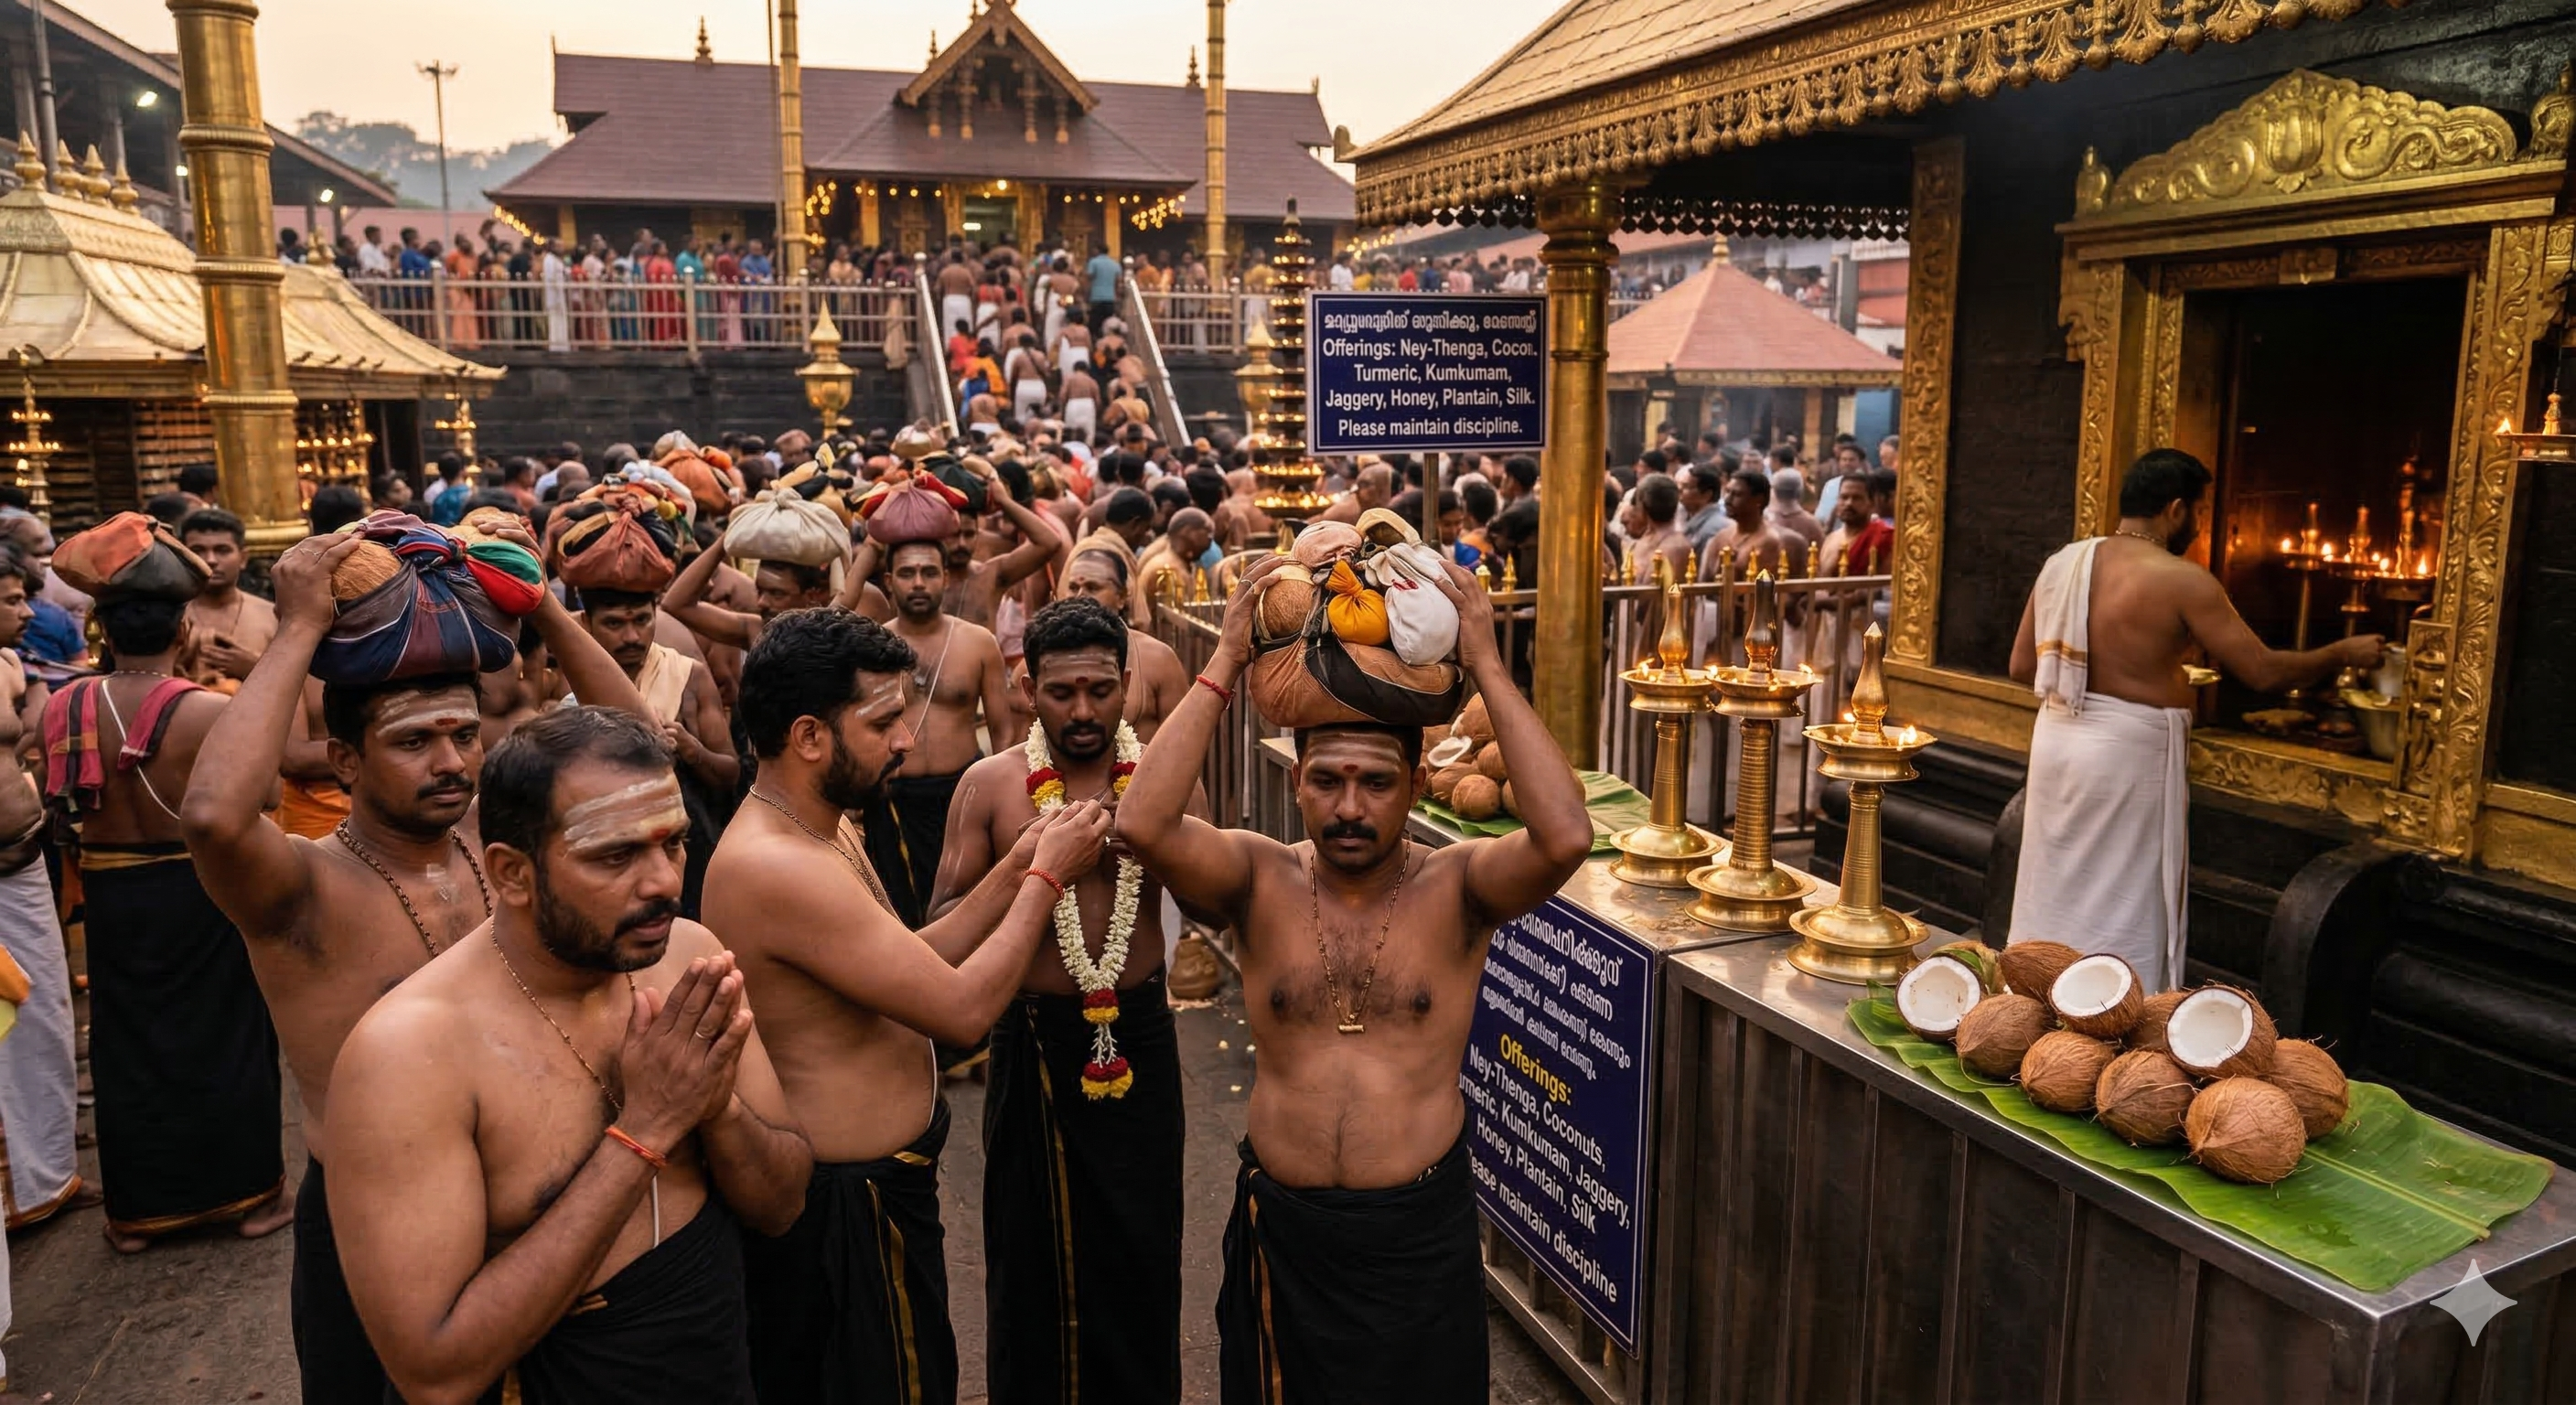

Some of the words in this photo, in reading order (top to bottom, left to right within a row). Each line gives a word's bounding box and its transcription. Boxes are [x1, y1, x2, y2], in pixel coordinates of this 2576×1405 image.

[1323, 338, 1396, 360] Offerings:
[1400, 338, 1488, 360] Ney-Thenga,
[1354, 363, 1422, 384] Turmeric,
[1425, 363, 1512, 382] Kumkumam,
[1325, 389, 1387, 411] Jaggery,
[1390, 388, 1439, 411] Honey,
[1443, 388, 1503, 407] Plantain,
[1506, 387, 1535, 405] Silk.
[1338, 418, 1387, 436] Please
[1390, 417, 1450, 435] maintain
[1454, 417, 1523, 438] discipline.
[1500, 1034, 1572, 1105] Offerings:
[1469, 1043, 1540, 1121] Ney-Thenga,
[1542, 1100, 1605, 1173] Coconuts,
[1458, 1072, 1498, 1121] urmeric,
[1501, 1100, 1573, 1183] Kumkumam,
[1575, 1164, 1630, 1229] Jaggery,
[1476, 1112, 1513, 1166] Honey,
[1516, 1144, 1567, 1214] Plantain,
[1571, 1193, 1596, 1234] Silk
[1466, 1143, 1497, 1191] ease
[1498, 1182, 1551, 1244] maintain
[1553, 1229, 1617, 1303] discipline
